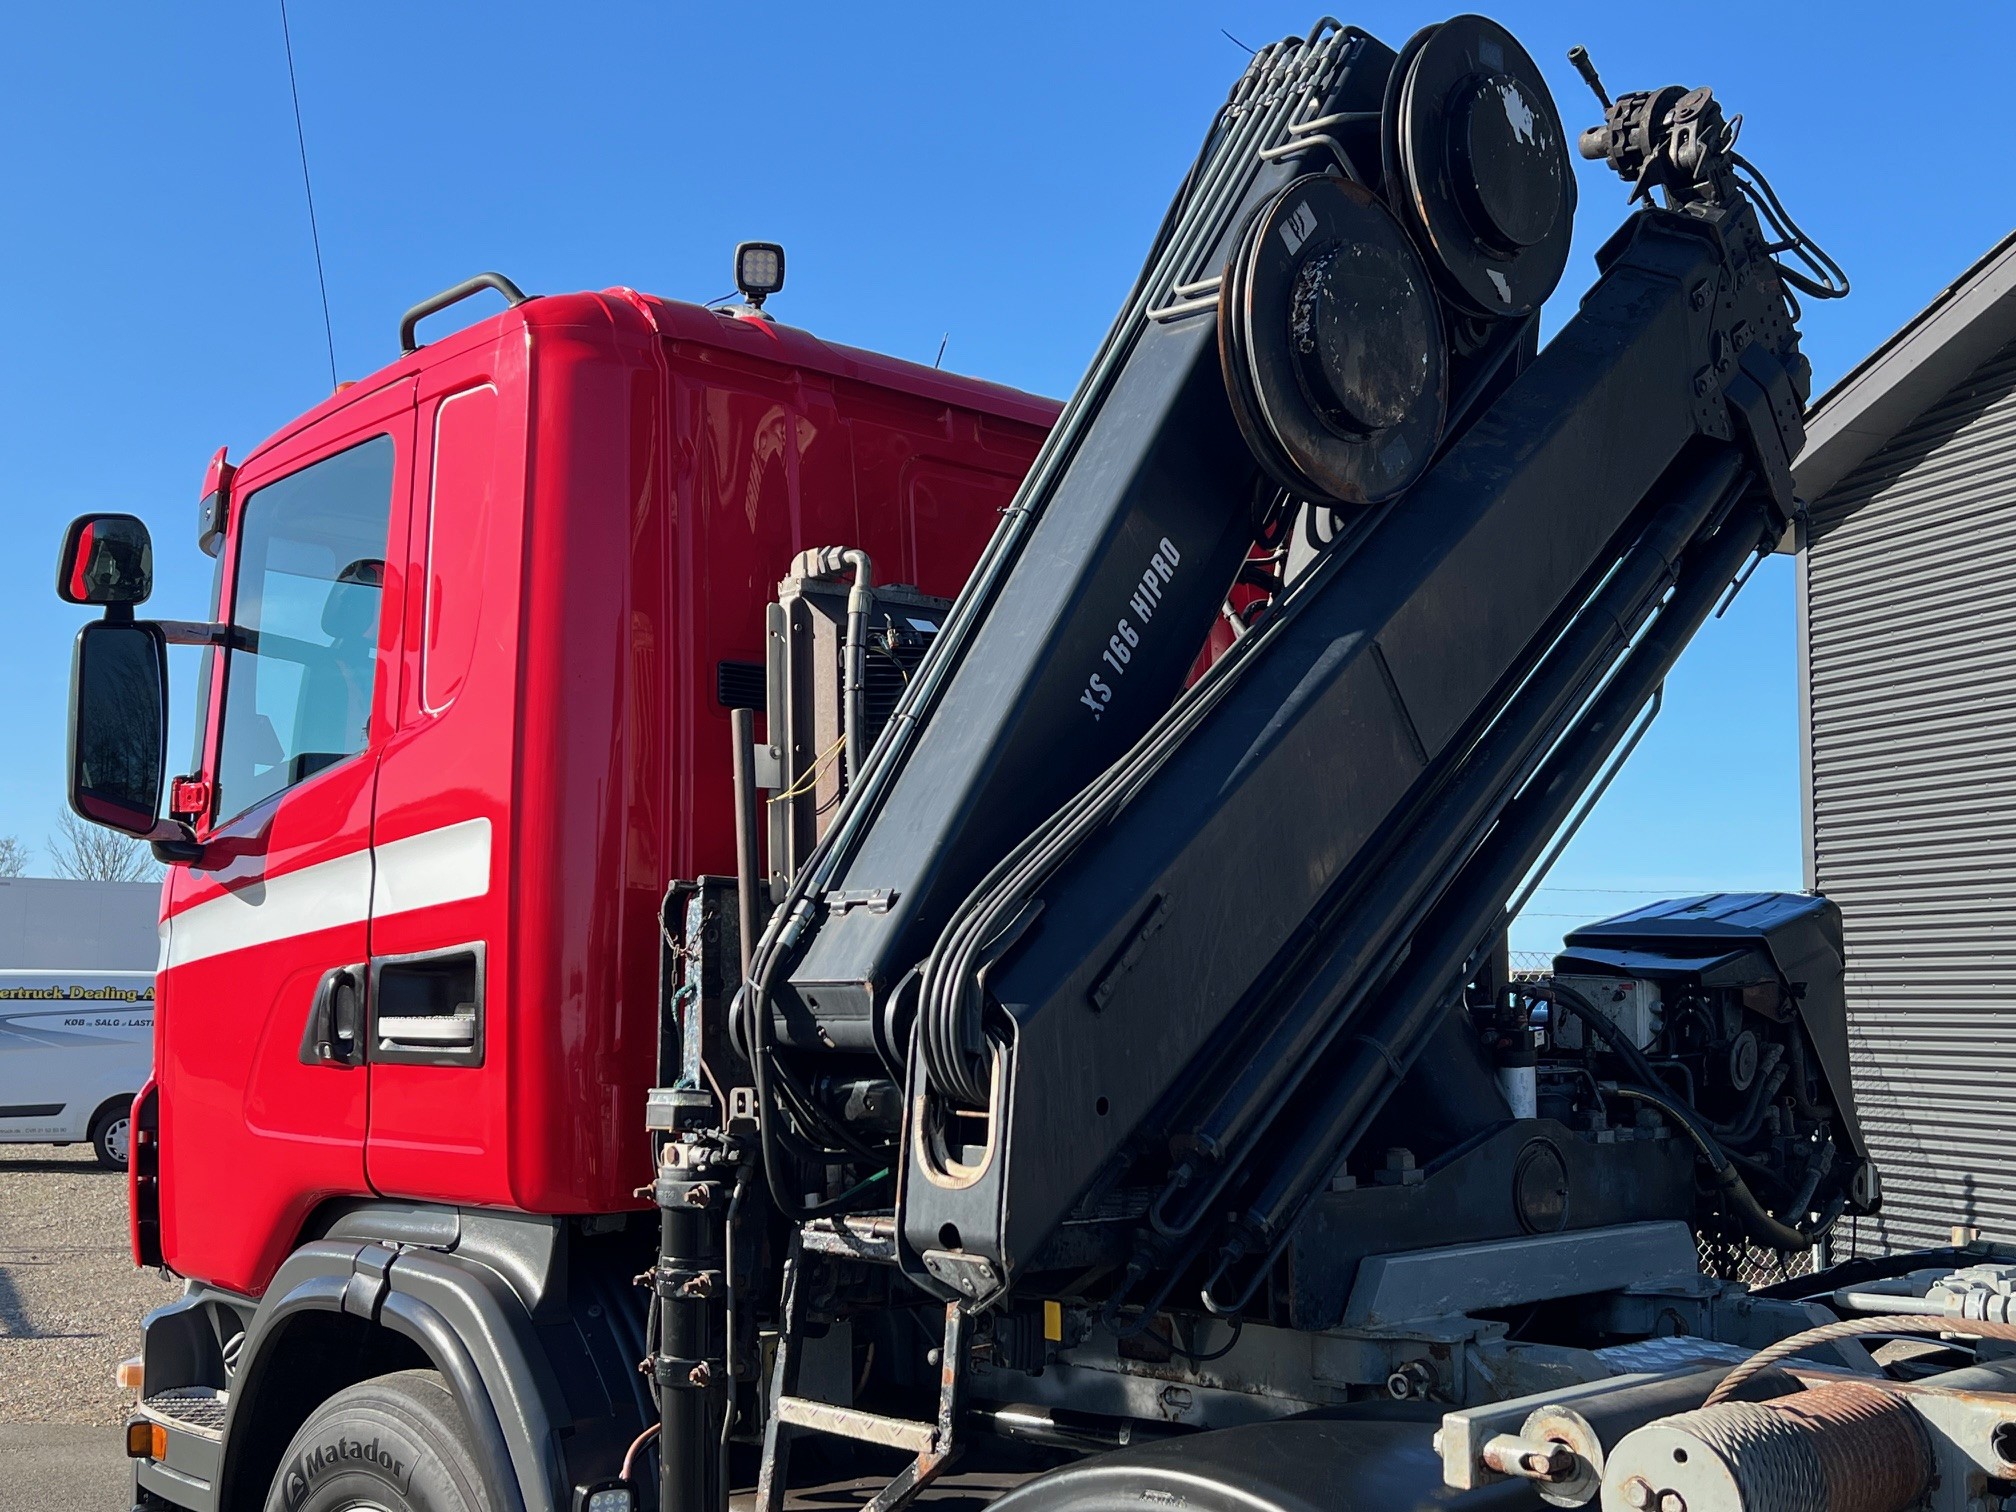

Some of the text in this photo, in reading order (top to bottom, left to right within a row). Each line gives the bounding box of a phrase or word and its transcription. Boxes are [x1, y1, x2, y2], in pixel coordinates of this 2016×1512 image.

[1080, 537, 1181, 722] XS 166 HIPRO
[0, 985, 64, 1000] ertruck
[69, 986, 138, 1002] Dealing
[64, 1019, 85, 1027] KØB
[95, 1019, 120, 1027] SALG
[305, 1436, 405, 1480] Matador
